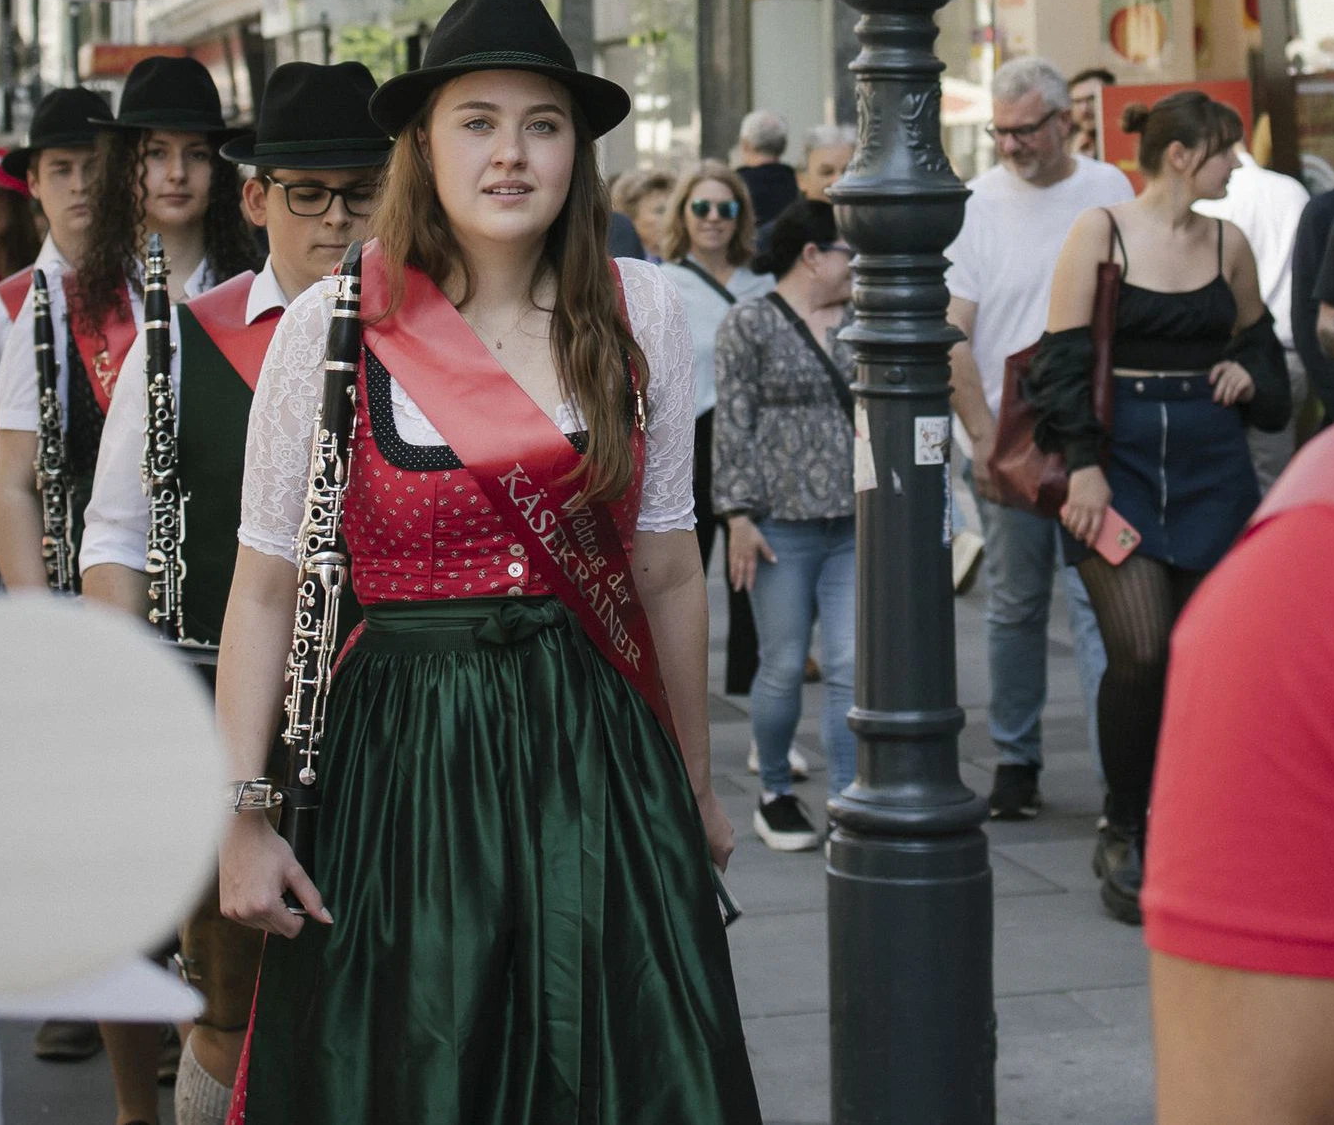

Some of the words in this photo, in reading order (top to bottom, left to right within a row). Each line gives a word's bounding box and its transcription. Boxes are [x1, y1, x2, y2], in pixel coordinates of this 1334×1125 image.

[497, 462, 642, 672] KÄSEKRAINER
[561, 489, 607, 574] Welttag
[607, 572, 631, 604] der
